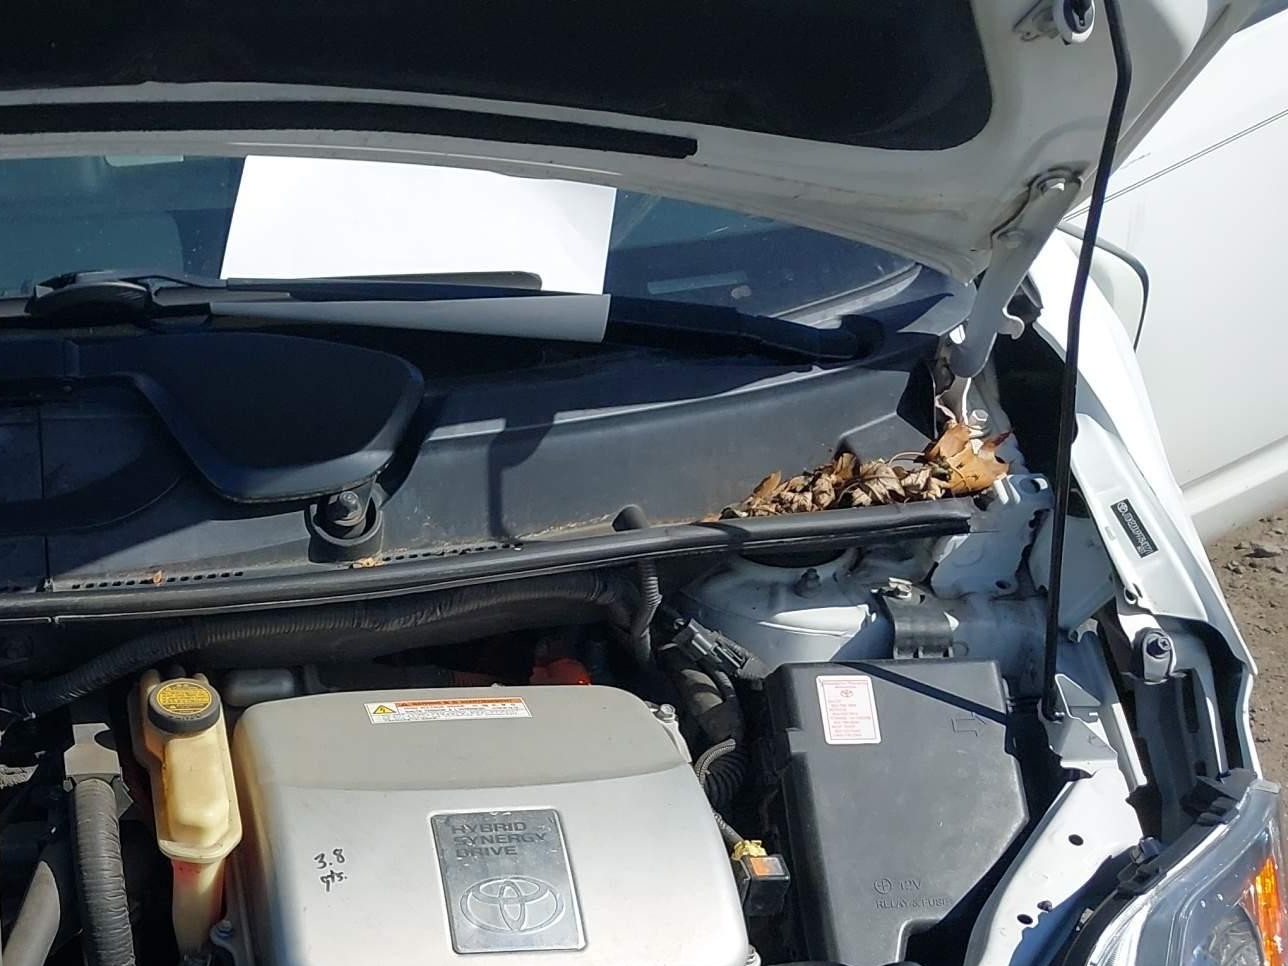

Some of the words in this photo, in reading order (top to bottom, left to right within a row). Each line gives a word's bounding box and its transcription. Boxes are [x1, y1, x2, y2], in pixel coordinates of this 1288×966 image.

[451, 821, 528, 835] HYBRID
[453, 832, 548, 847] SYNERGY
[456, 845, 519, 858] DRIVE
[314, 848, 345, 869] 3.8
[899, 879, 921, 891] 12V
[875, 899, 910, 909] RELAY
[921, 897, 949, 907] FUSE
